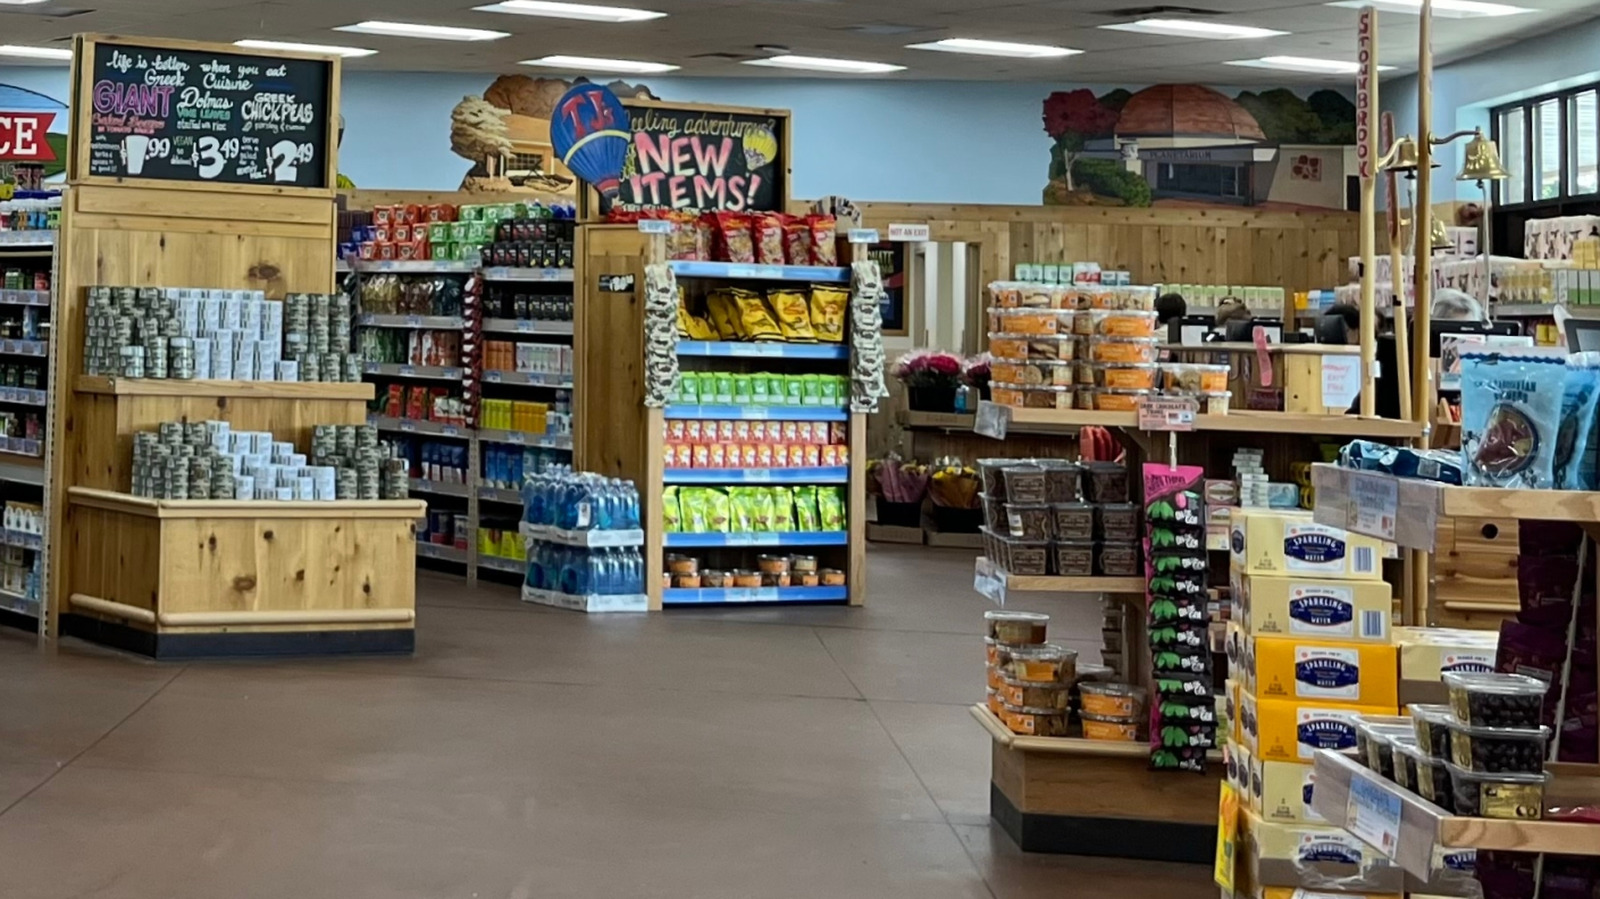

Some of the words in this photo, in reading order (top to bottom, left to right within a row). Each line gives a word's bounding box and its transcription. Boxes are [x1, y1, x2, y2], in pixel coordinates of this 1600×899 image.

[135, 54, 148, 69] is
[199, 59, 231, 73] when
[237, 65, 259, 79] you
[265, 64, 287, 77] eat
[144, 68, 185, 87] Greek
[202, 72, 254, 90] Cuisine
[93, 79, 175, 118] GIANT
[176, 86, 234, 109] Dolmas
[253, 92, 296, 104] GREEK
[192, 135, 240, 179] $3.49
[266, 140, 314, 183] $2.49
[634, 131, 733, 177] NEW
[629, 171, 761, 212] ITEMS!
[890, 228, 902, 236] NOT
[904, 228, 912, 236] AN
[914, 228, 927, 237] EXIT
[1293, 535, 1336, 548] SPARKLING
[1299, 597, 1343, 611] SPARKLING
[1304, 660, 1346, 672] SPARKLING
